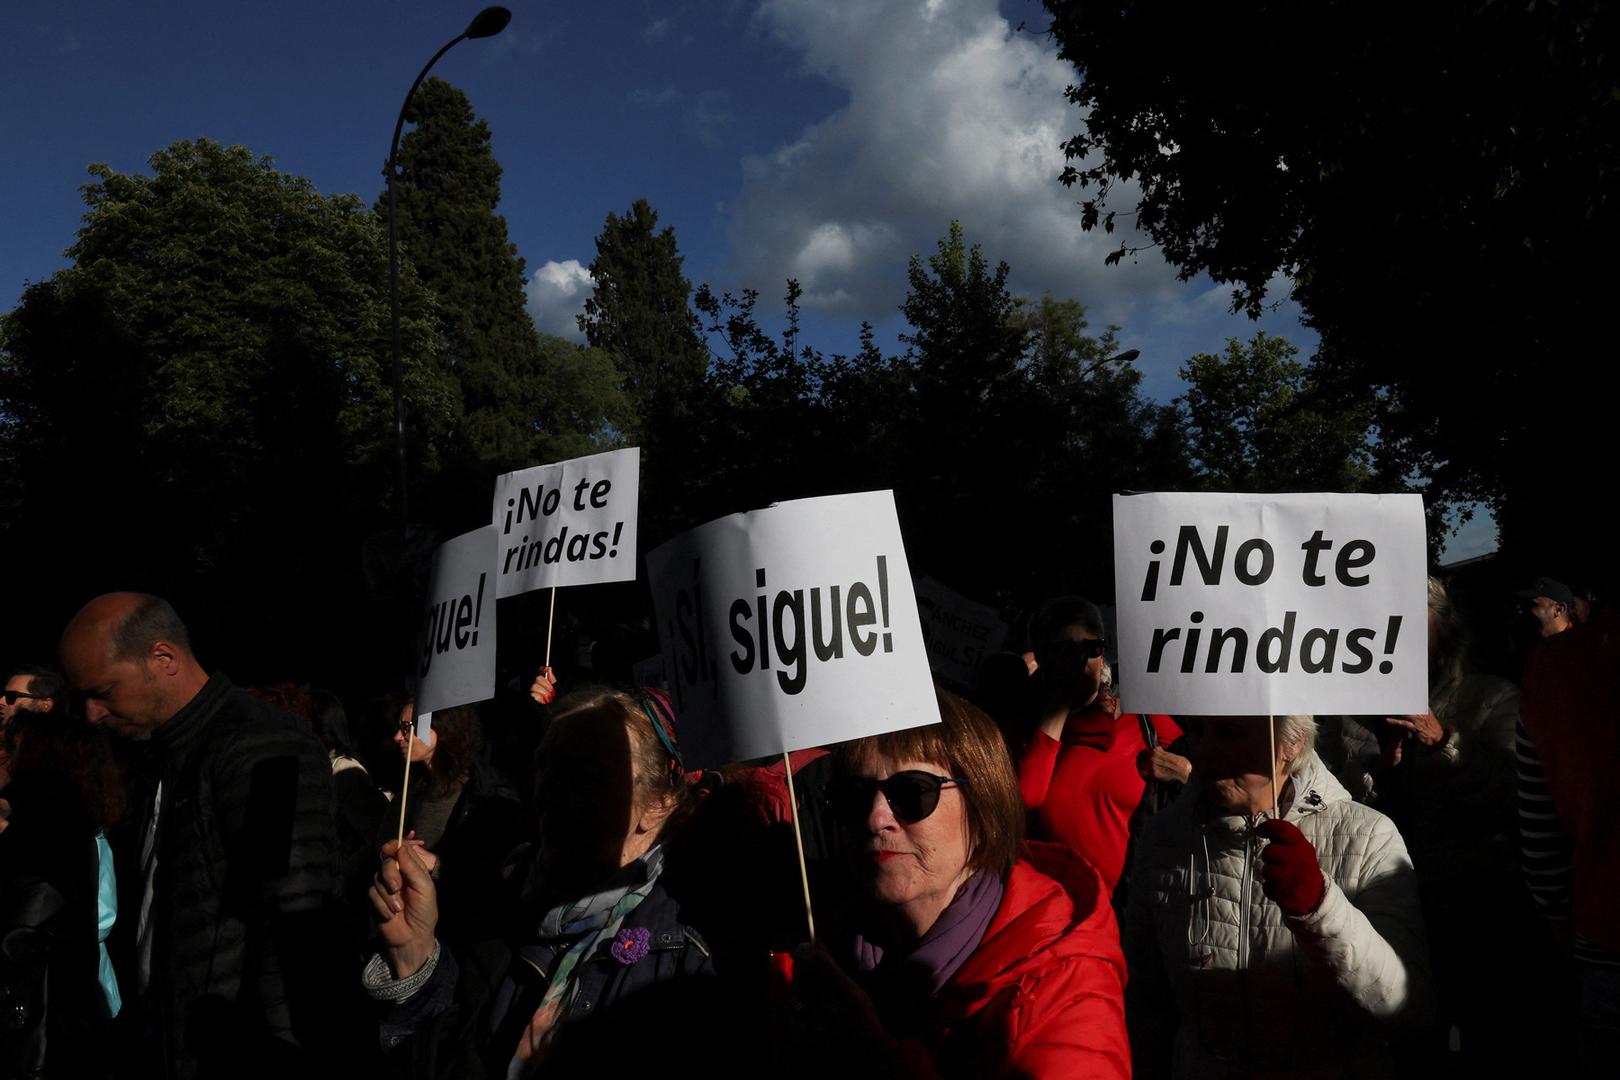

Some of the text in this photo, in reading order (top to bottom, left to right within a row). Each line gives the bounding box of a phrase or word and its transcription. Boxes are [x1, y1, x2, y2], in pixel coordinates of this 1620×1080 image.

[503, 477, 611, 535] ¡No te
[502, 521, 624, 574] rindas!
[1139, 525, 1377, 602] ¡No te
[728, 555, 893, 697] sigue!
[1147, 611, 1403, 675] rindas!
